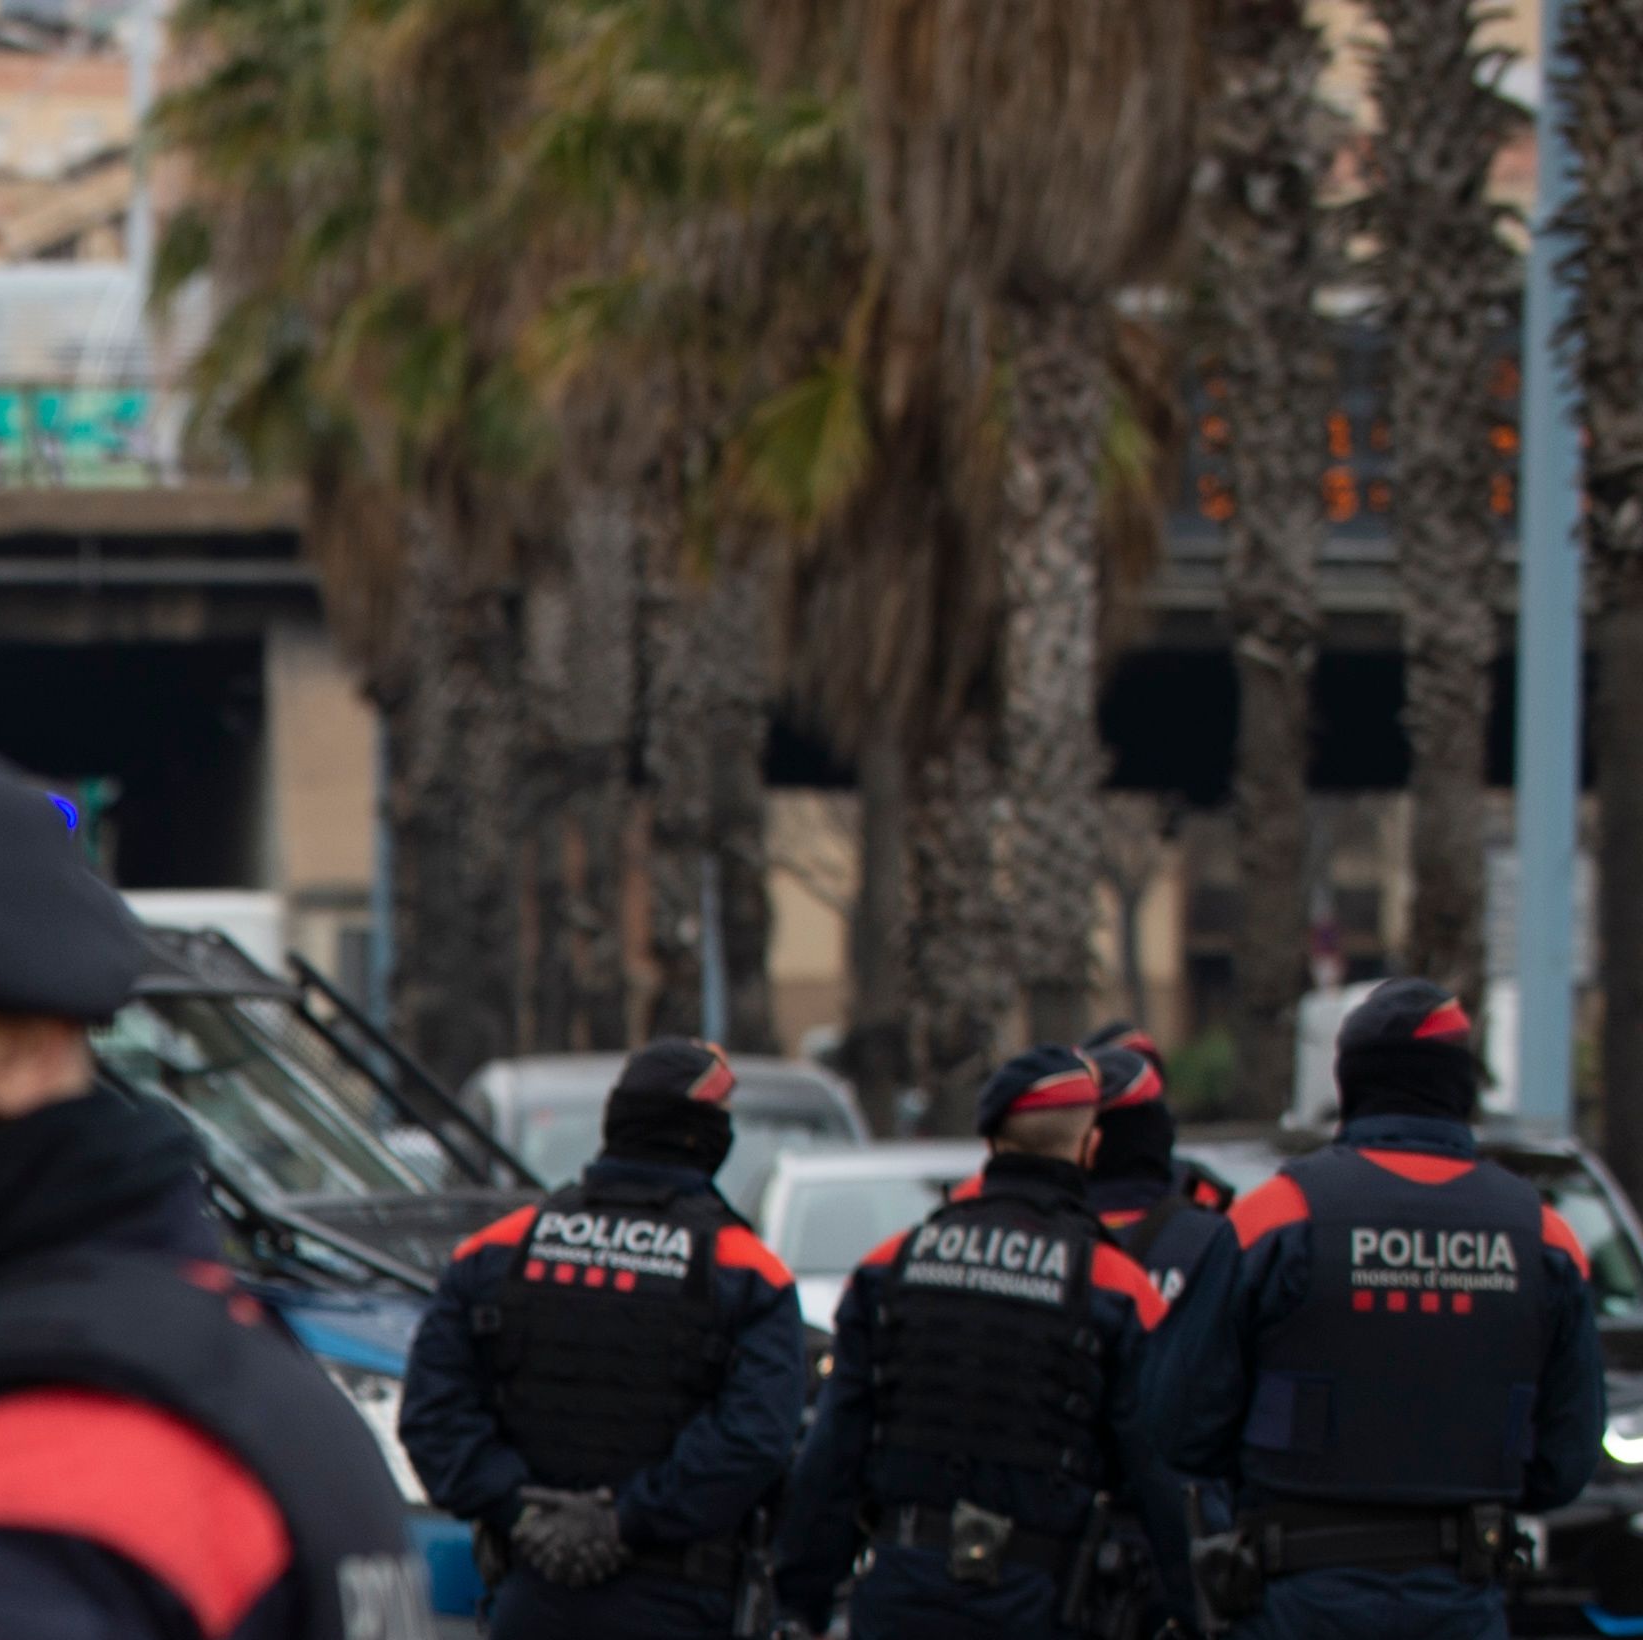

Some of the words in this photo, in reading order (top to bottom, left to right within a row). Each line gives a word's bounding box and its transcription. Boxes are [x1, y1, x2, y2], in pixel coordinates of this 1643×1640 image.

[534, 1211, 692, 1261] POLICIA
[911, 1223, 1067, 1280] POLICIA
[1350, 1227, 1517, 1272] POLICIA
